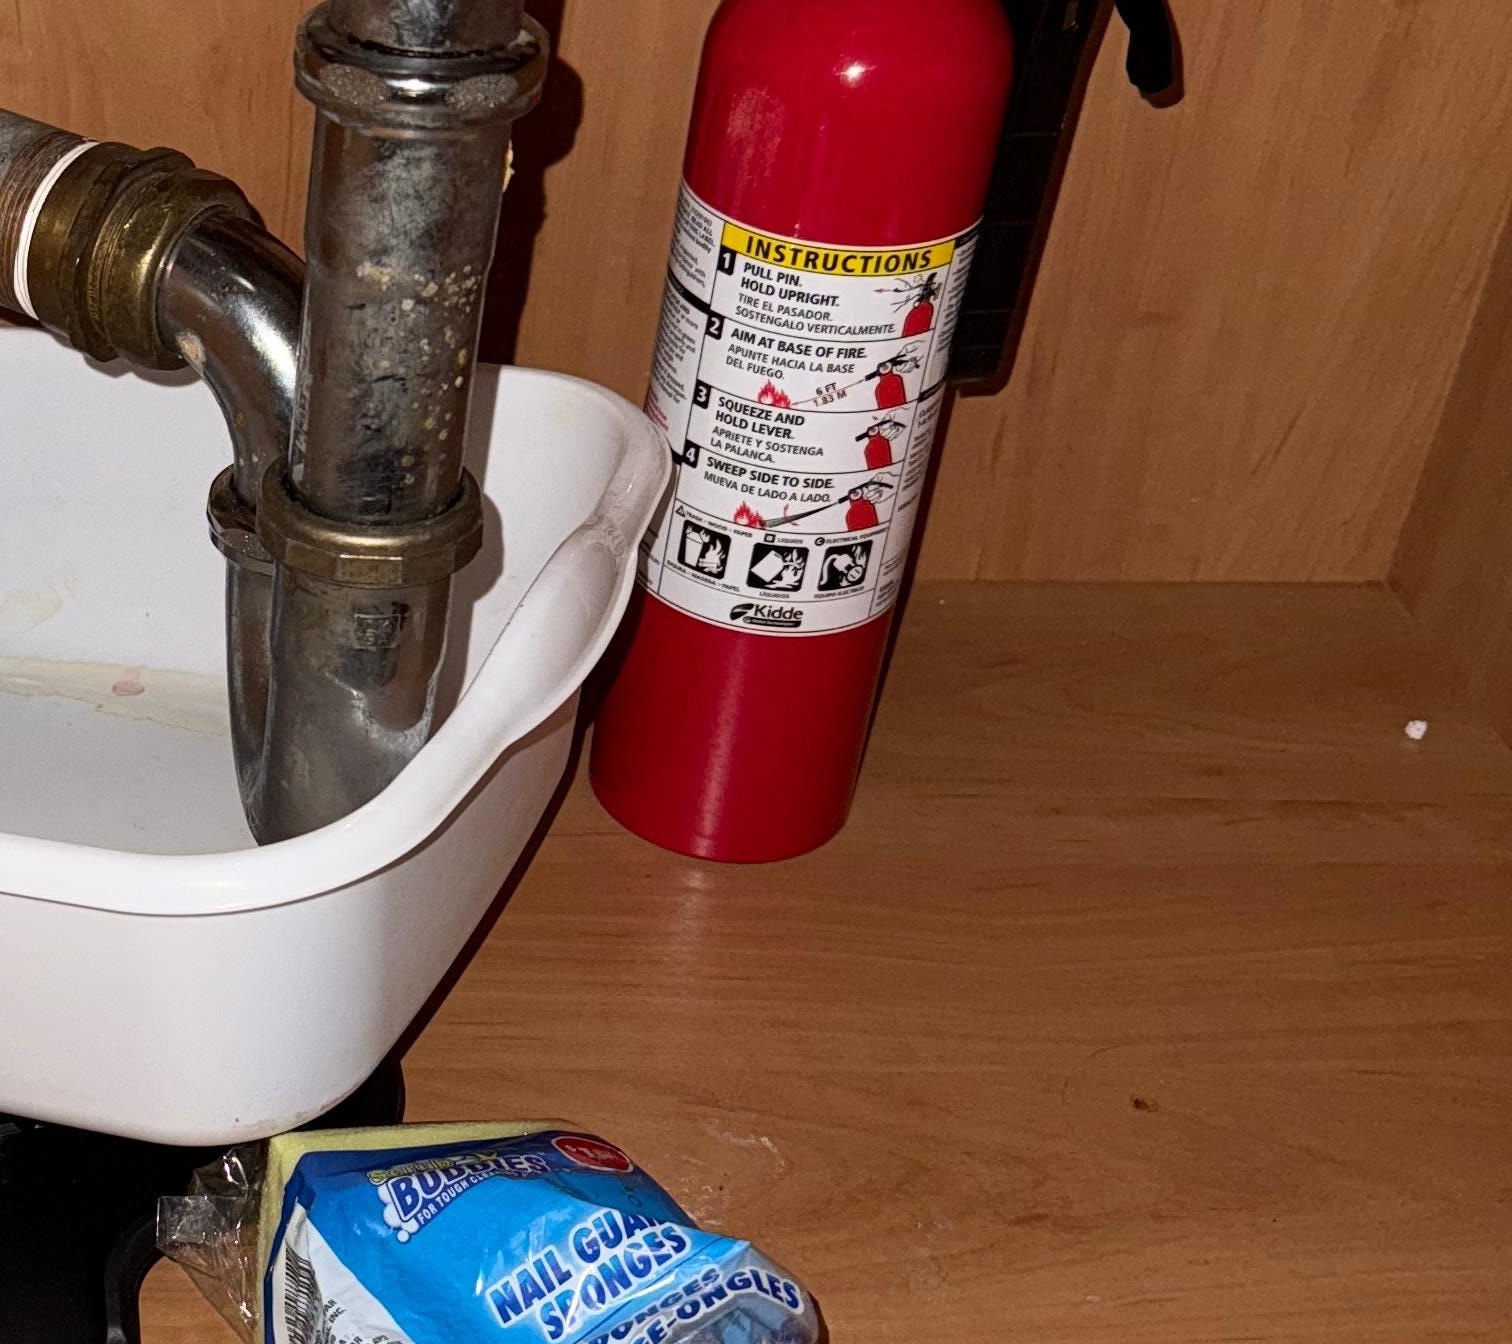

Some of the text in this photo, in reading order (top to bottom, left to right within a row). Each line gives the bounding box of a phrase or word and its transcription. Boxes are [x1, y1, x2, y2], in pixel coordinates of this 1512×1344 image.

[723, 252, 731, 271] 1
[745, 236, 932, 274] INSTRUCTIONS
[743, 262, 803, 287] PULL PIN.
[738, 293, 759, 309] TIRE
[762, 301, 774, 313] EL
[741, 277, 840, 307] HOLD UPRIGHT.
[709, 318, 720, 335] 2
[735, 306, 804, 331] SOSTENGALO
[731, 328, 755, 345] AIM
[757, 336, 774, 349] AT
[777, 341, 812, 357] BASE
[815, 346, 834, 358] OF
[726, 356, 785, 380] DEL FUEGO.
[727, 344, 855, 374] APUNTE HACIA LA BASE
[696, 385, 707, 402] 3
[815, 382, 838, 396] 6 FT
[715, 410, 795, 439] HOLD LEVER.
[718, 396, 805, 426] SQUEEZE AND
[685, 447, 696, 462] 4
[710, 437, 722, 449] LA
[712, 425, 824, 457] APRIETE Y SOSTENGA
[703, 471, 738, 491] MUEVA
[741, 483, 755, 494] DE
[757, 487, 786, 501] LADO
[789, 492, 797, 501] A
[706, 456, 746, 477] SWEEP
[749, 468, 779, 485] SIDE
[783, 477, 799, 488] TO
[754, 604, 804, 620] Kidde
[417, 1203, 438, 1225] FOR
[435, 1179, 469, 1207] TOUGH
[489, 1249, 572, 1324] NAIL
[540, 1225, 688, 1341] SPONGES
